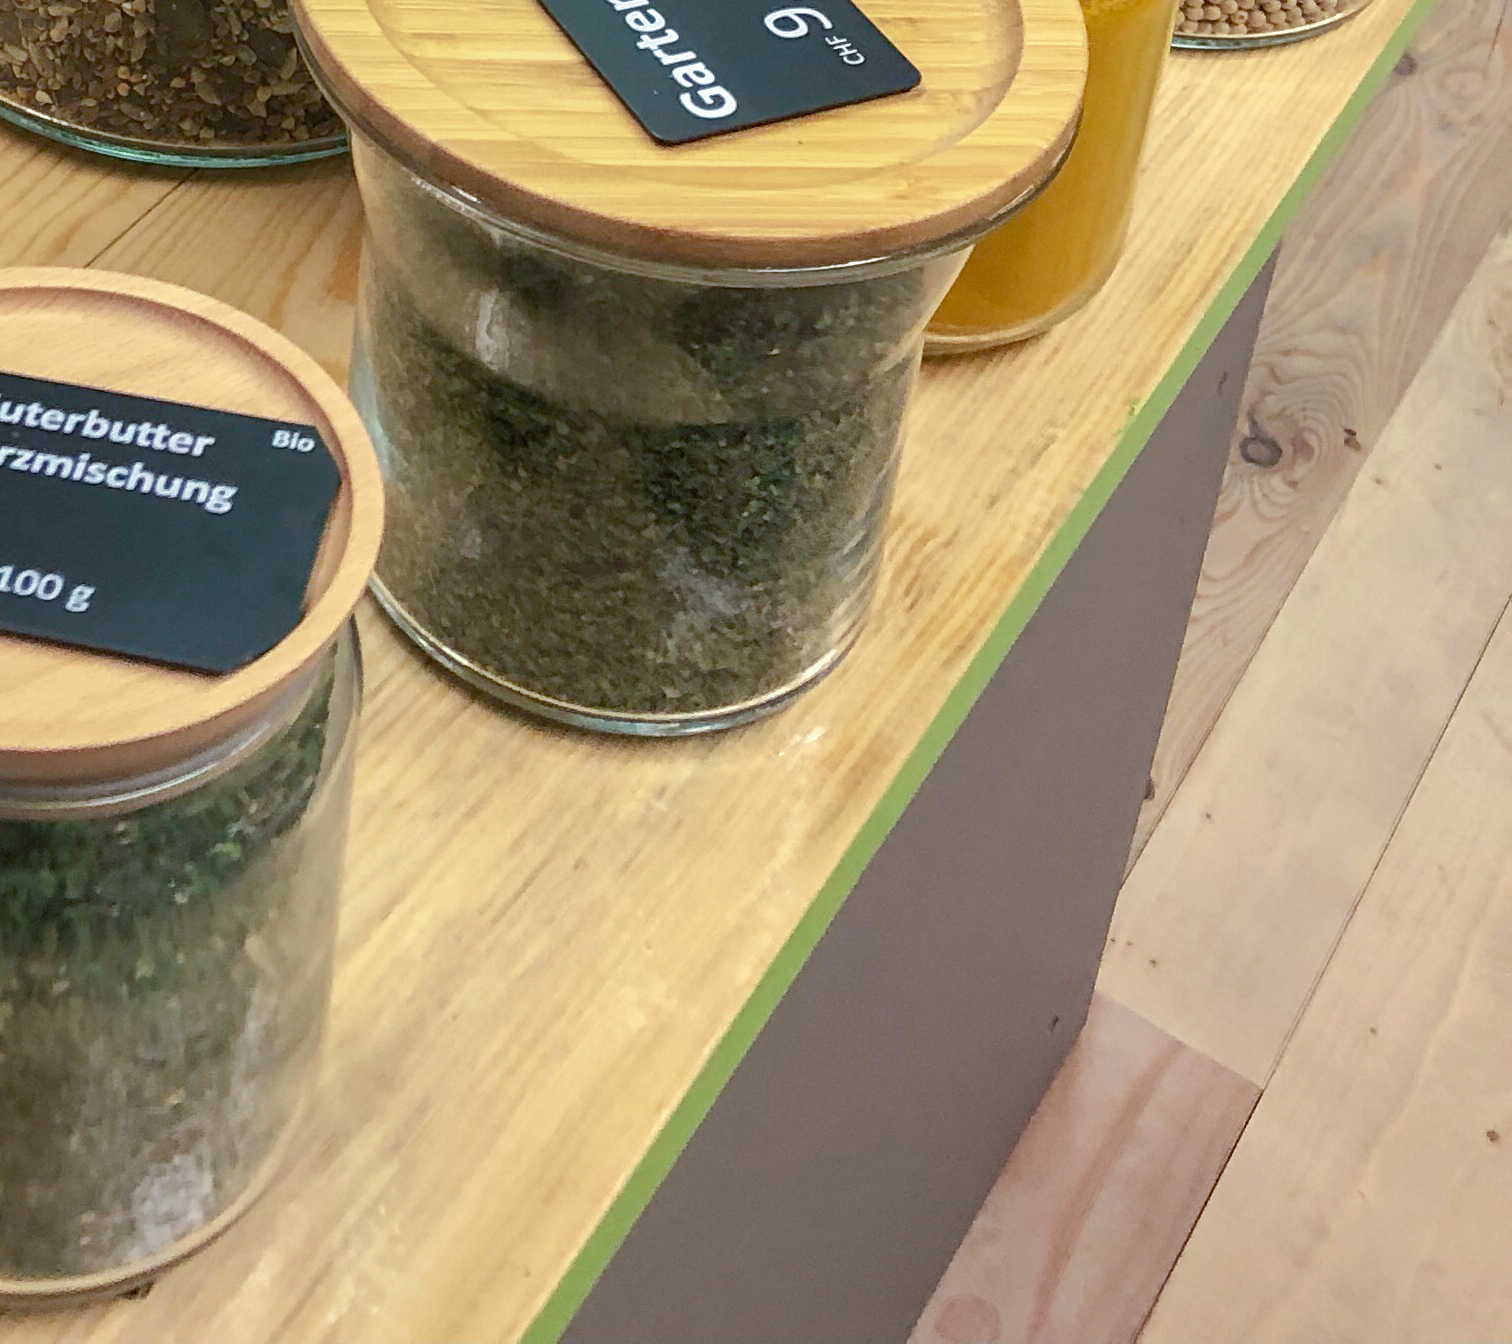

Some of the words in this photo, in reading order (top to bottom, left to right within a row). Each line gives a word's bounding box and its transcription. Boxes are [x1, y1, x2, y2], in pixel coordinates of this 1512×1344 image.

[823, 33, 867, 68] CHF
[270, 428, 317, 454] Bio
[66, 580, 98, 613] g
